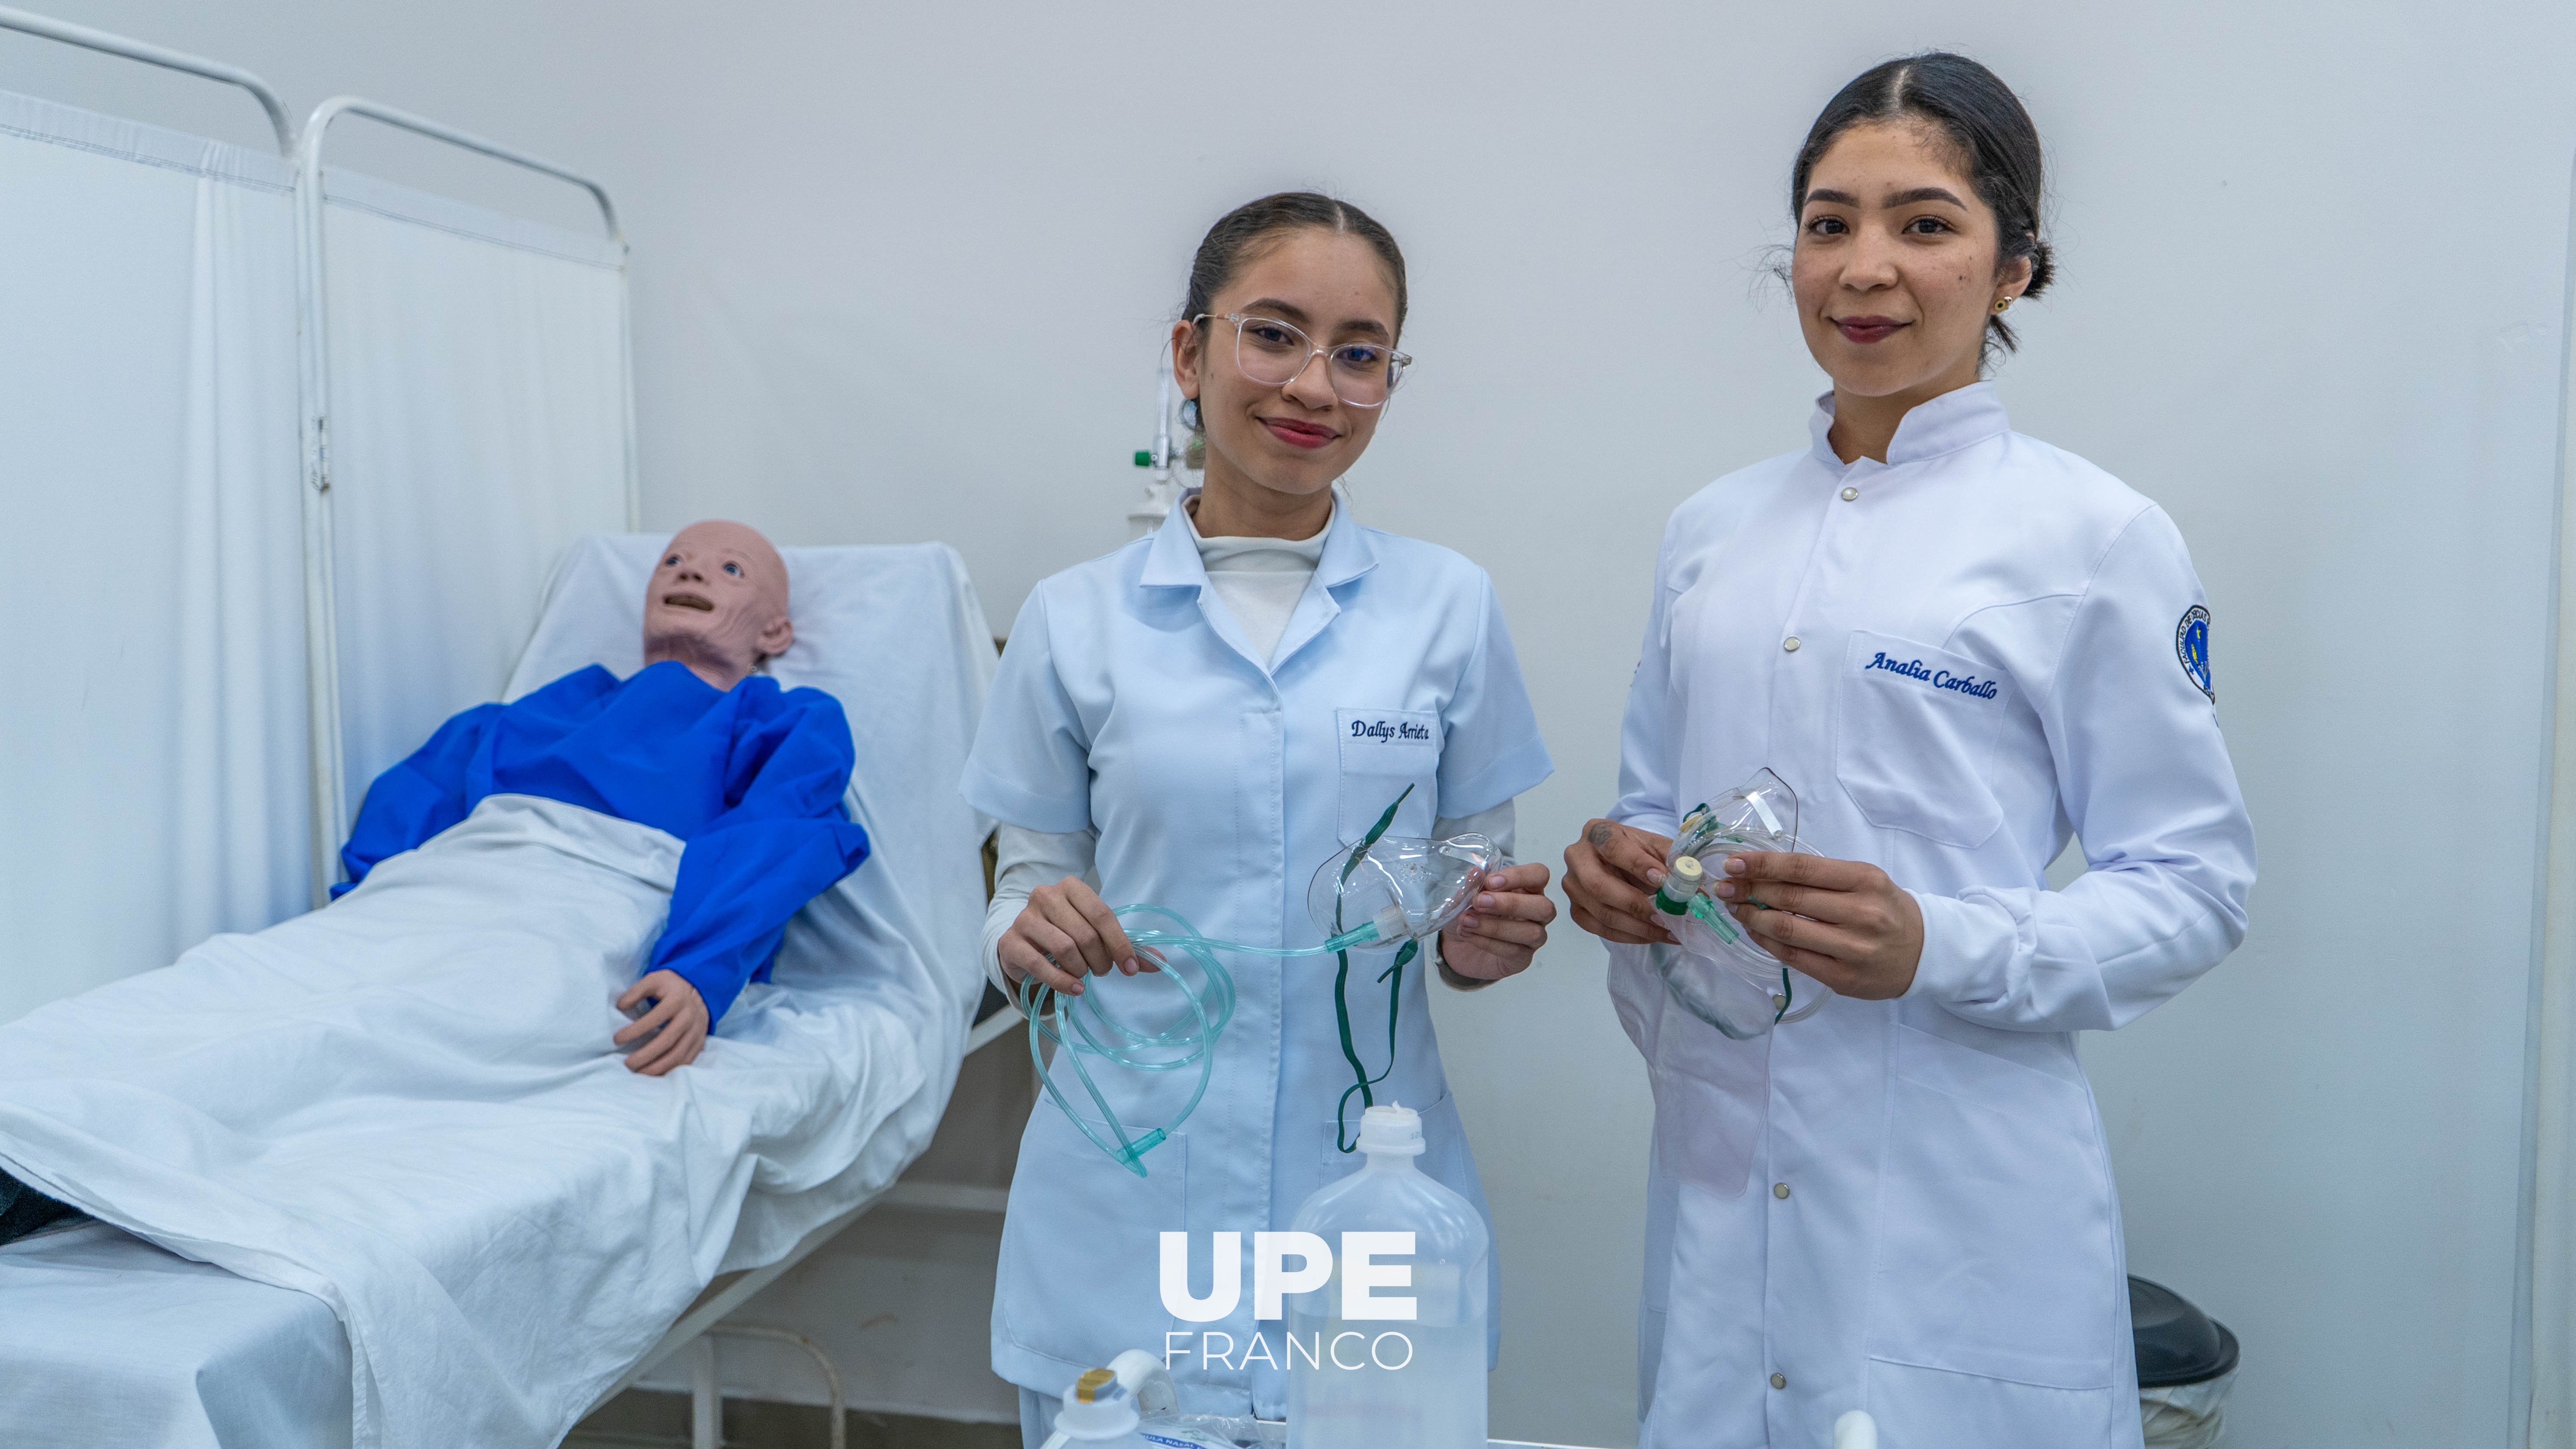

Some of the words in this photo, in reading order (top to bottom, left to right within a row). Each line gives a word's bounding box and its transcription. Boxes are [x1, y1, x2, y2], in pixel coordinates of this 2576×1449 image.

[2179, 626, 2190, 664] FACULTAD
[2185, 615, 2192, 628] DE
[1864, 652, 1932, 682] Analia
[1934, 670, 1998, 699] Carballo
[1351, 719, 1395, 743] Dallys
[1398, 721, 1429, 740] Arrieta
[1165, 1439, 1195, 1449] NASAL
